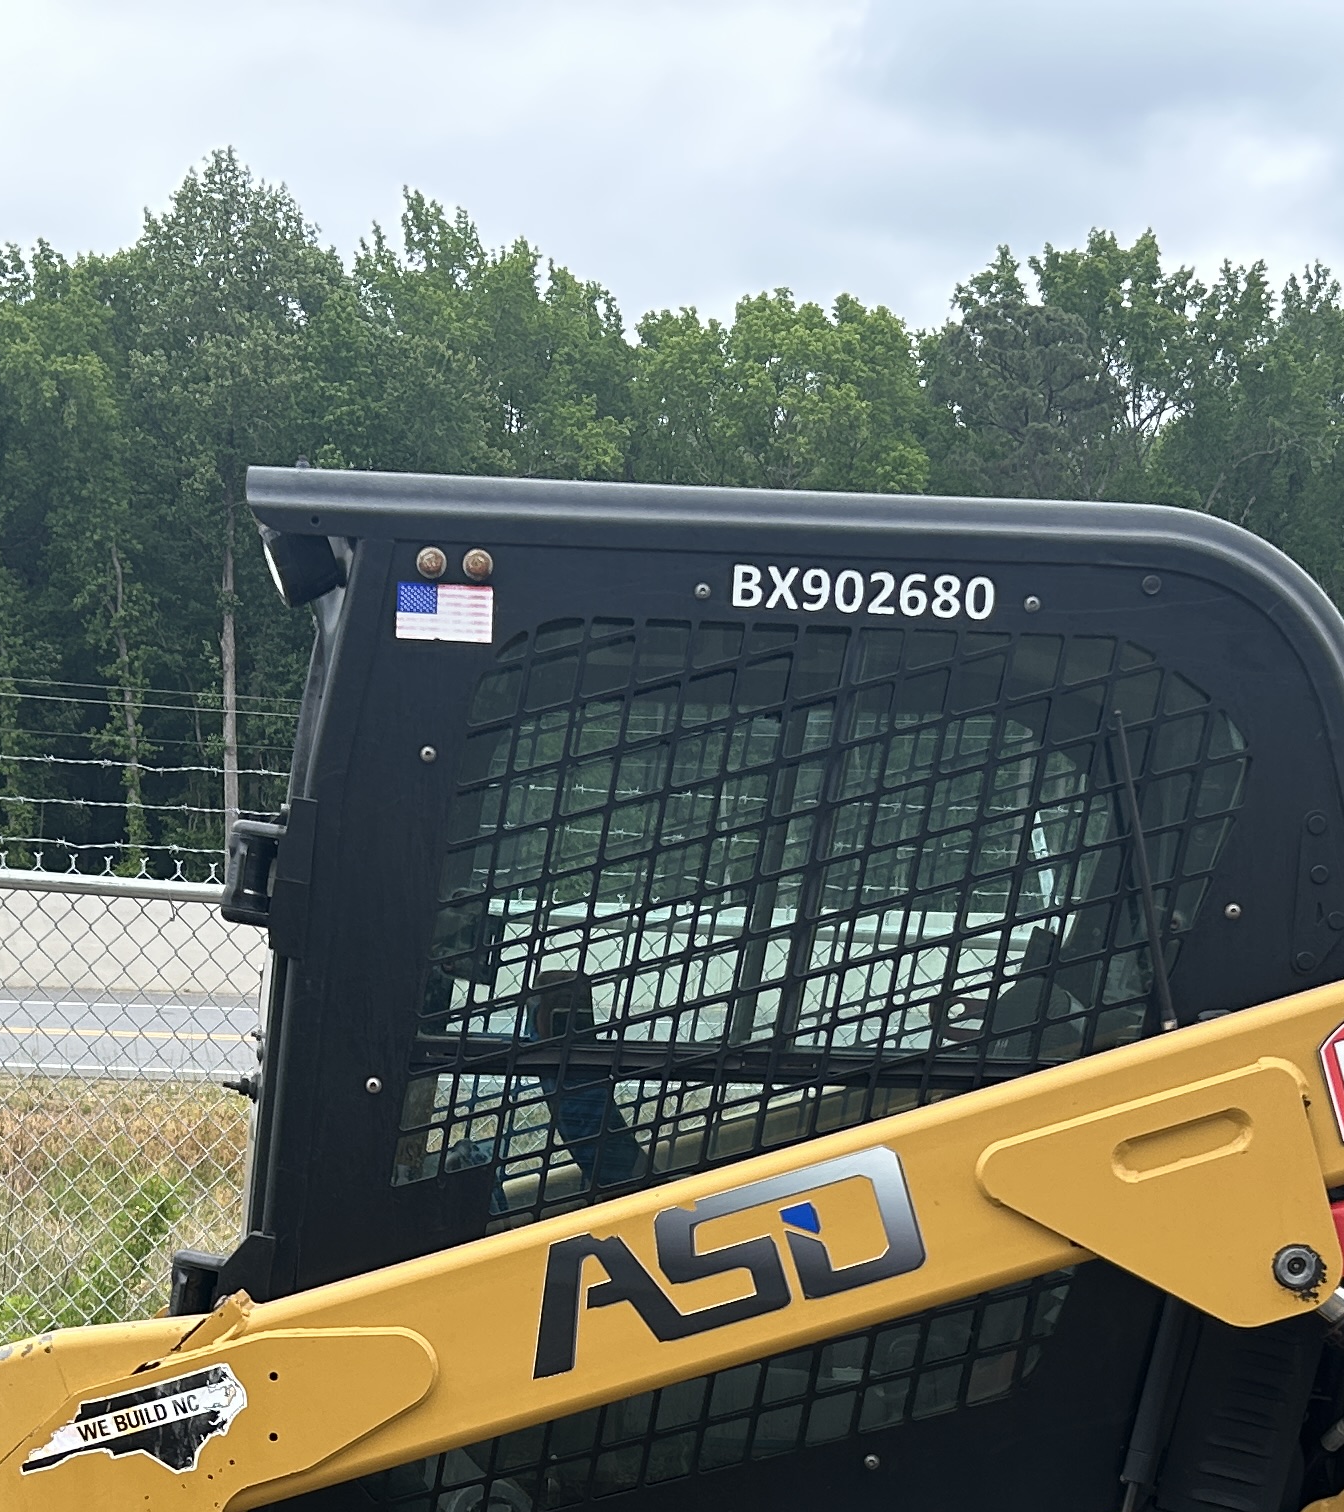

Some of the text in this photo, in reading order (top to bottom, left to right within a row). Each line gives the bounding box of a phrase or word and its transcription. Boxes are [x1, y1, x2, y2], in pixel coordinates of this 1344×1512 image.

[731, 563, 995, 621] BX902680
[532, 1144, 927, 1381] ASD
[76, 1394, 200, 1442] WE BUILD NC
